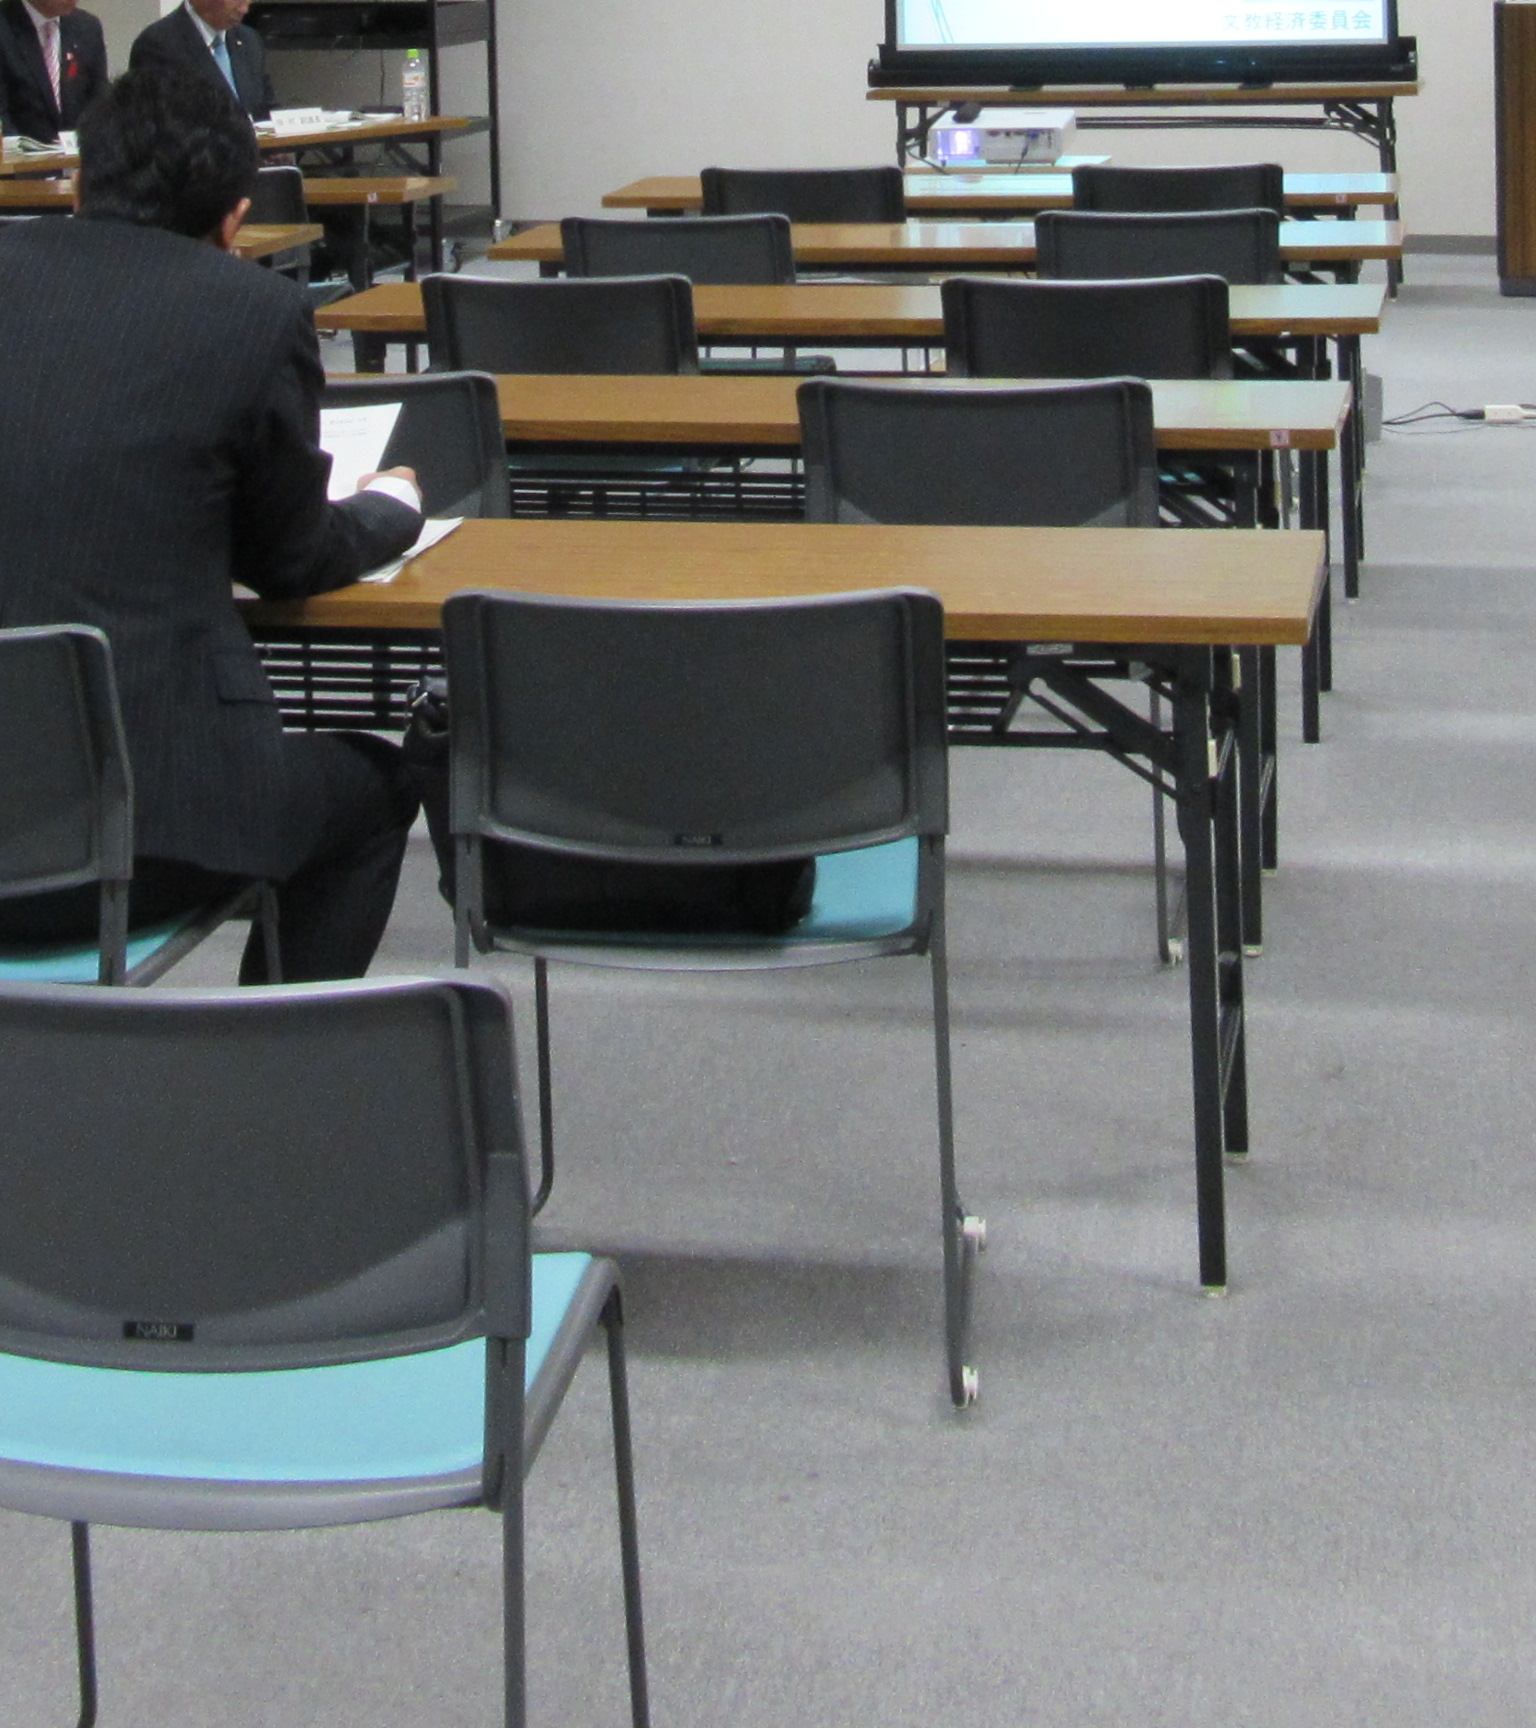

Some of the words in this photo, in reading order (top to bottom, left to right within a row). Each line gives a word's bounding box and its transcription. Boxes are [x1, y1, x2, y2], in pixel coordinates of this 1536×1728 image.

[1221, 9, 1373, 31] 文教経済委員会
